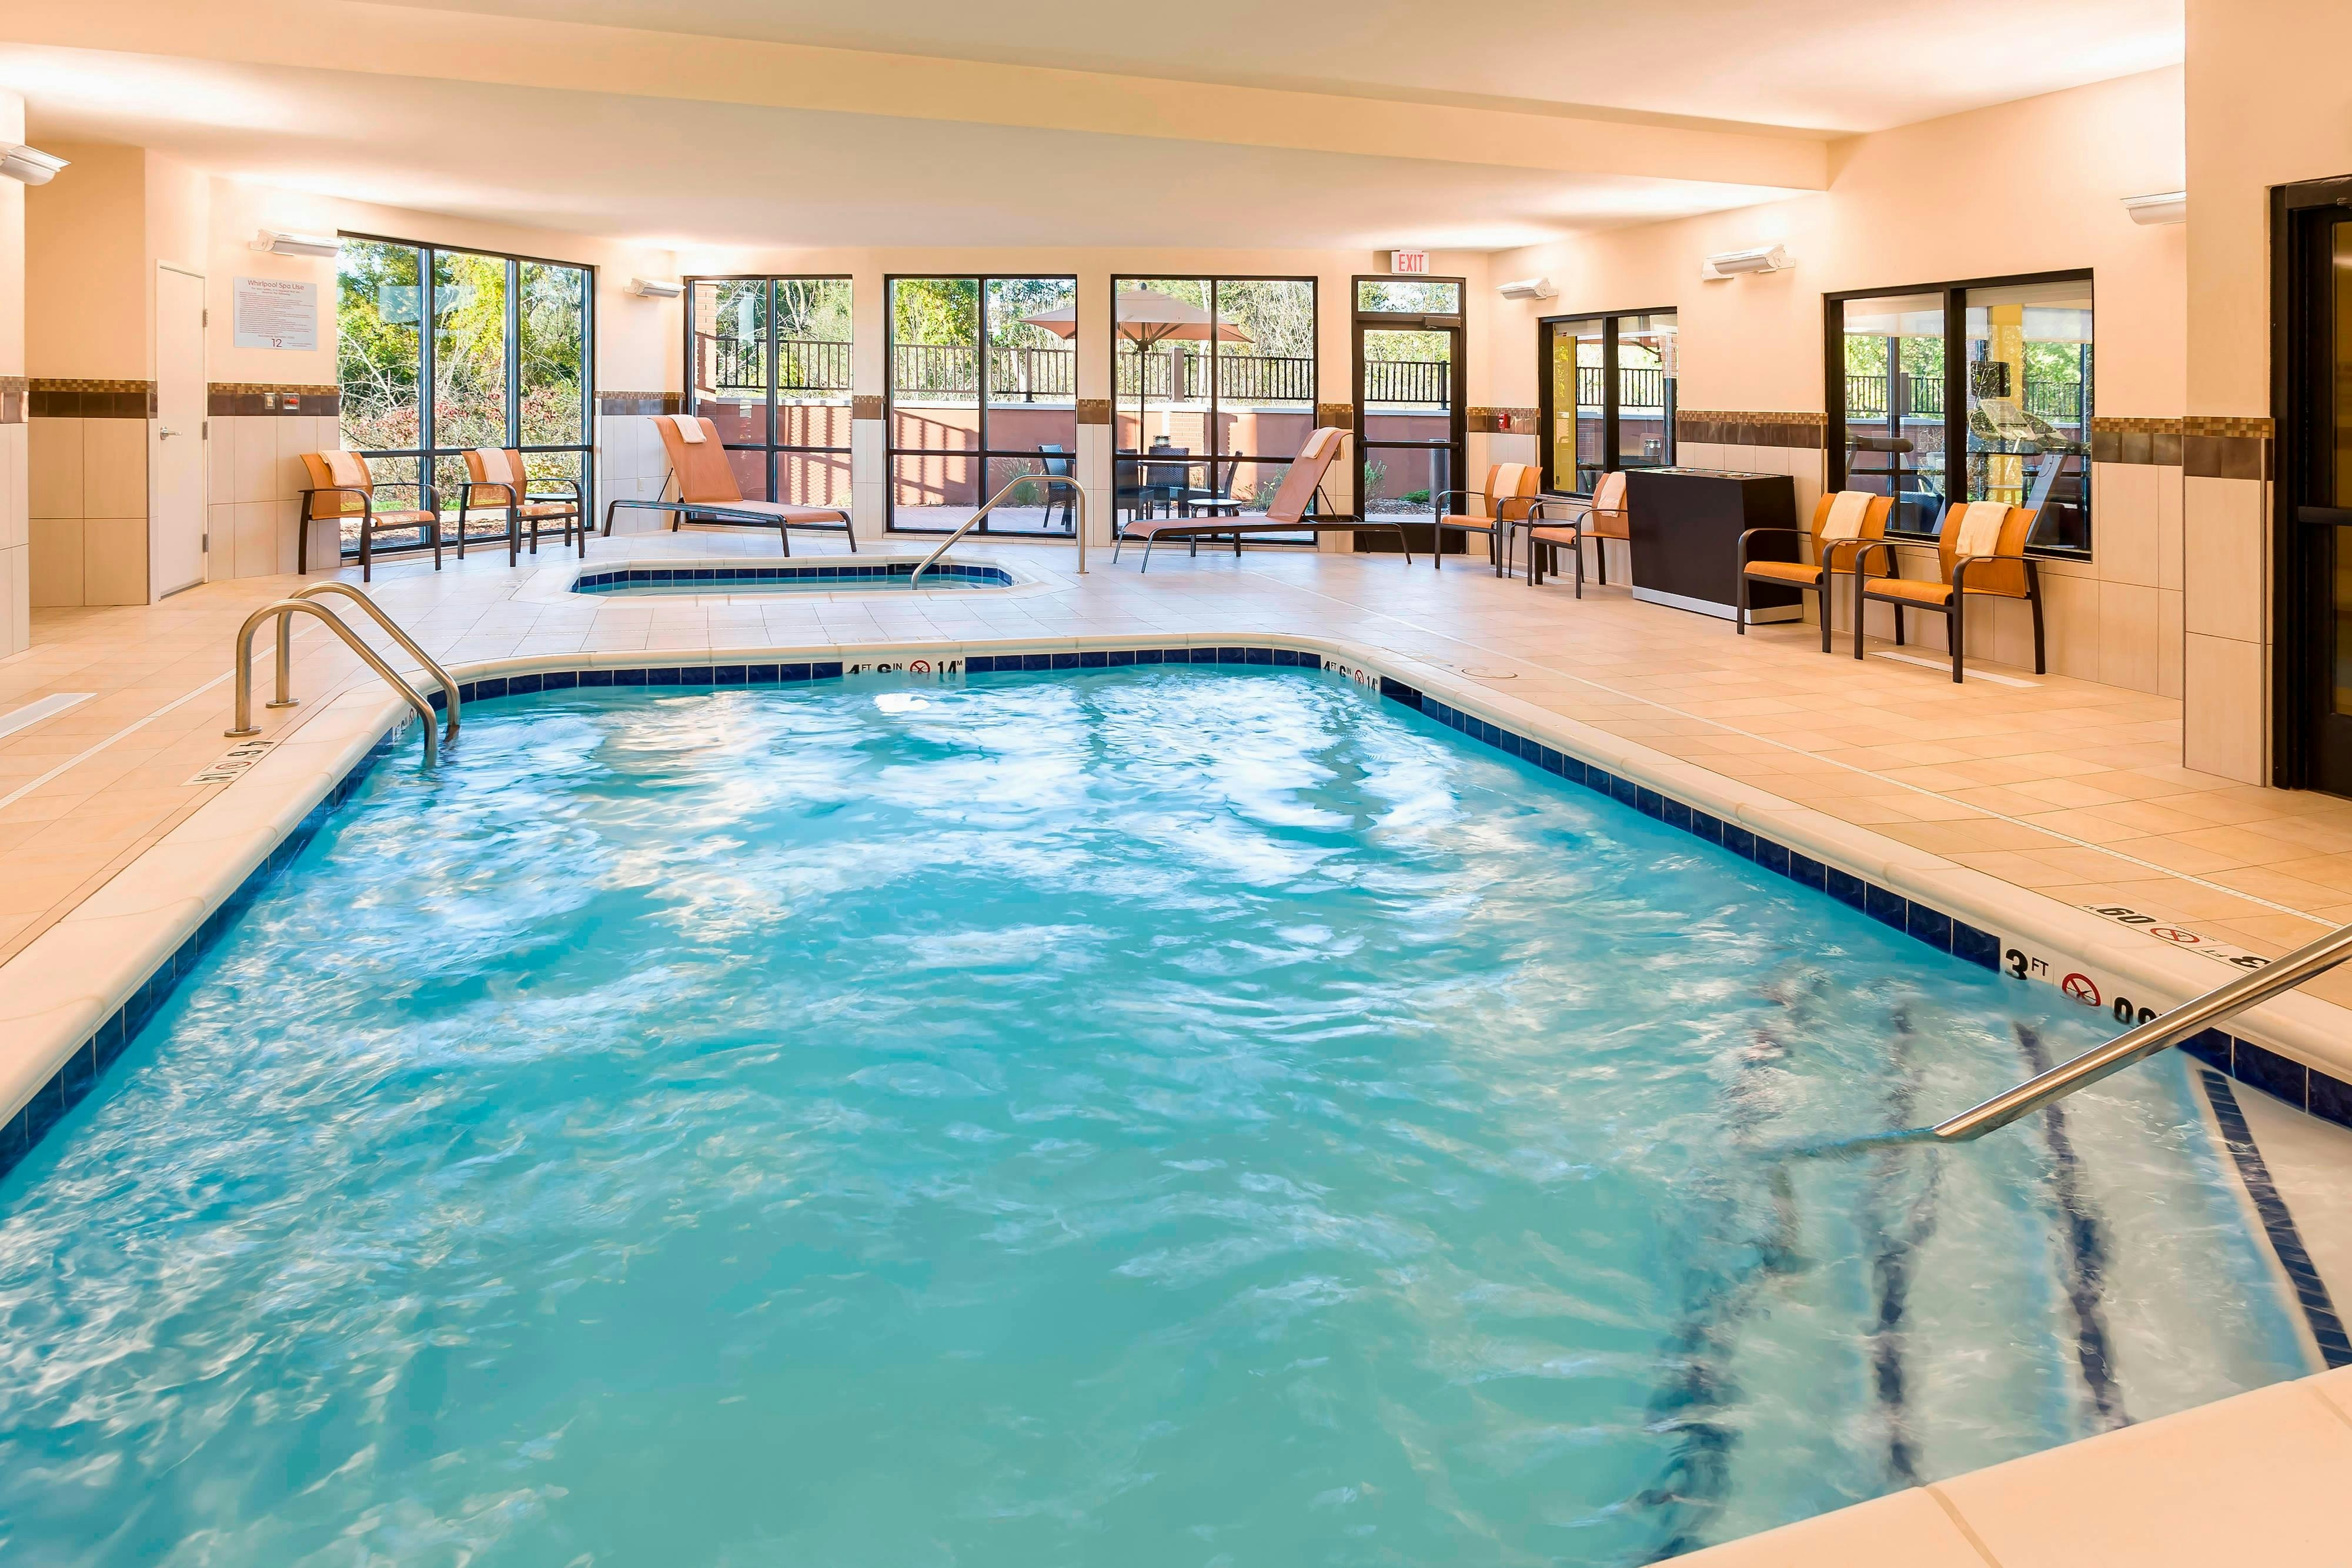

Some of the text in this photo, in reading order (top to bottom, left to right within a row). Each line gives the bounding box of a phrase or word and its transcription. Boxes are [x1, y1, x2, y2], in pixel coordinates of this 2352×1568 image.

[1398, 254, 1424, 272] EXIT
[248, 279, 278, 288] Whirlpool
[271, 339, 282, 347] 12
[2004, 948, 2028, 981] 3
[2031, 957, 2050, 977] FT
